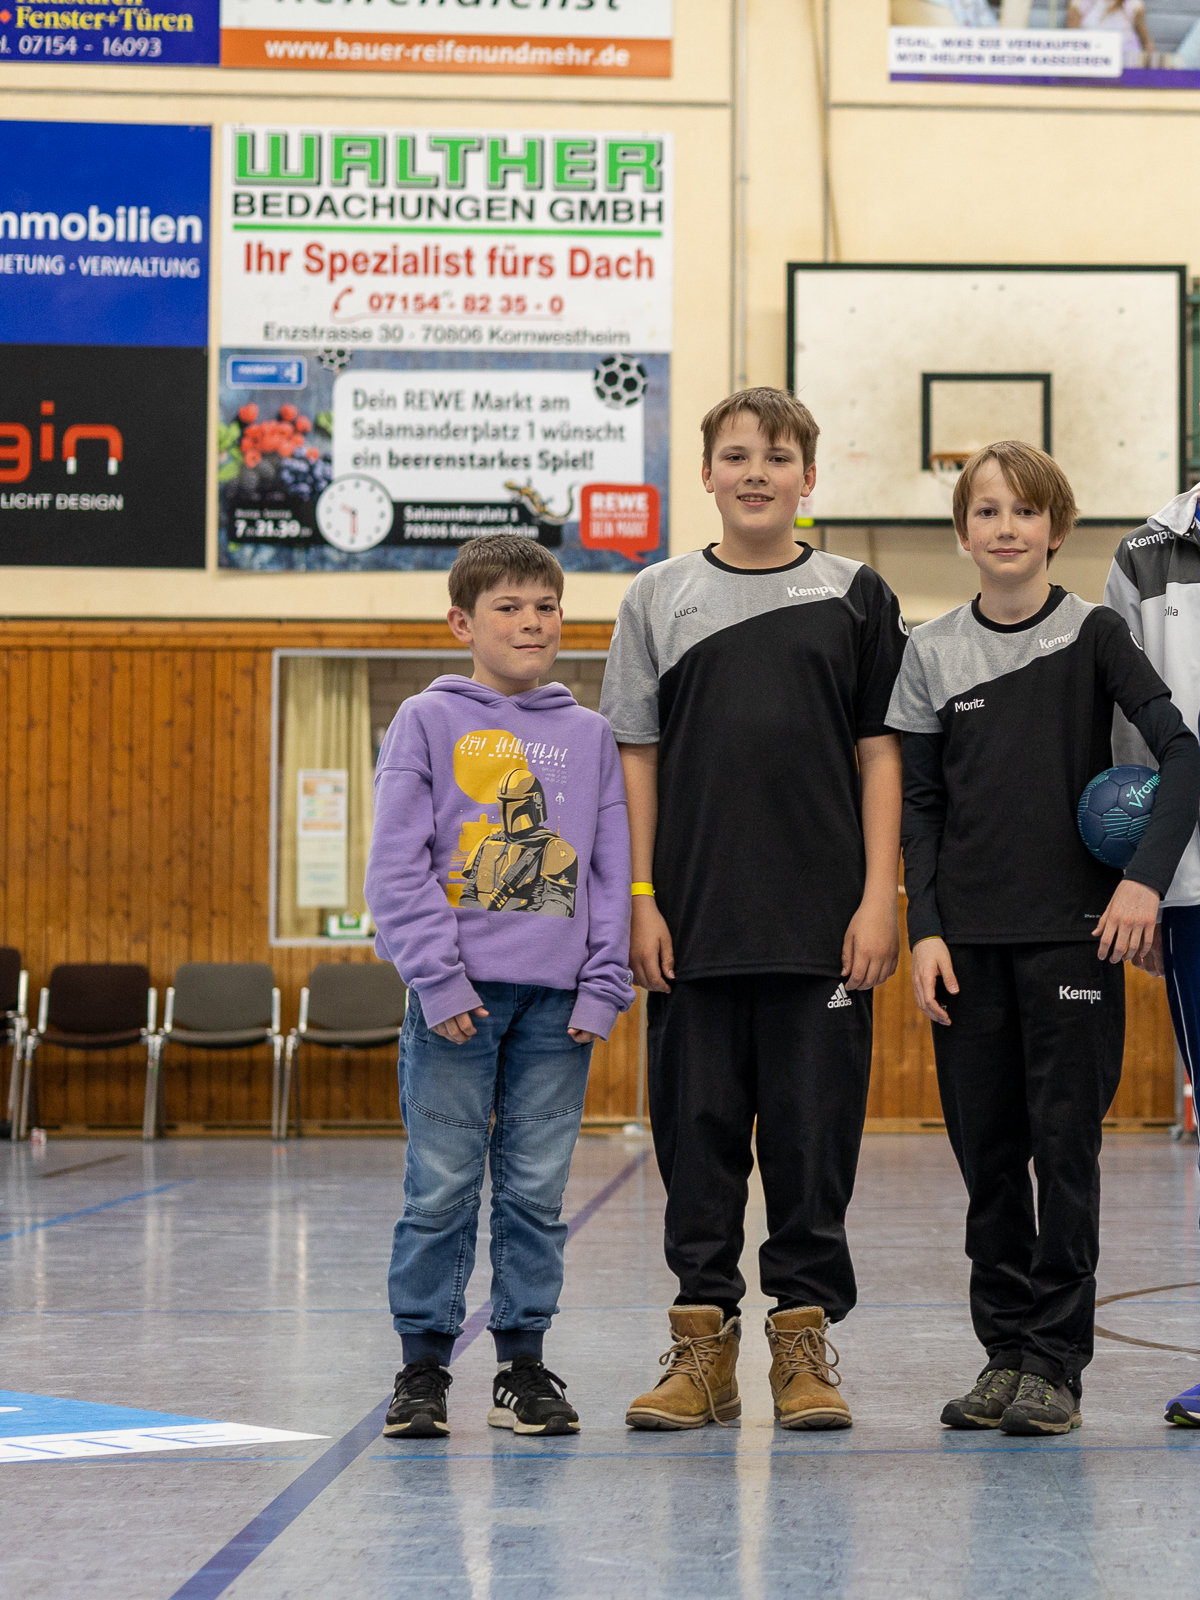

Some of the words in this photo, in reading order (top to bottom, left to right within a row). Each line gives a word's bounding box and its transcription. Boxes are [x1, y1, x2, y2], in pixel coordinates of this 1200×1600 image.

[15, 6, 195, 32] Fenster+Türen
[18, 35, 78, 56] 07154
[102, 37, 163, 57] 16093
[265, 37, 631, 68] www.bauer-reifenundmehr.de
[233, 130, 665, 194] WALTHER
[233, 193, 536, 222] BEDACHUNGEN
[549, 197, 664, 224] GMBH
[78, 255, 201, 279] VERWALTUNG
[244, 243, 291, 274] Ihr
[303, 242, 476, 284] Spezialist
[487, 245, 556, 279] fürs
[568, 246, 656, 280] Dach
[368, 293, 441, 313] 07154
[462, 295, 491, 314] 82
[500, 295, 528, 314] 35
[550, 295, 564, 314] 0
[263, 321, 373, 343] Enzstrasse
[379, 325, 404, 343] 30
[421, 325, 484, 345] 70806
[488, 326, 631, 346] Kornwestheim
[353, 388, 398, 410] Dein
[404, 390, 465, 412] REWE
[472, 391, 535, 412] Markt
[540, 397, 570, 412] am
[352, 418, 519, 443] Salamanderplatz
[528, 421, 536, 440] 1
[541, 422, 626, 442] wünscht
[352, 448, 382, 468] ein
[387, 448, 531, 470] beerenstarkes
[538, 451, 595, 474] Spiel!
[0, 493, 52, 509] LICHT
[55, 494, 124, 511] DESIGN
[591, 492, 649, 511] REWE
[674, 605, 698, 619] Luca
[954, 698, 985, 713] Moritz
[826, 997, 853, 1009] adidas
